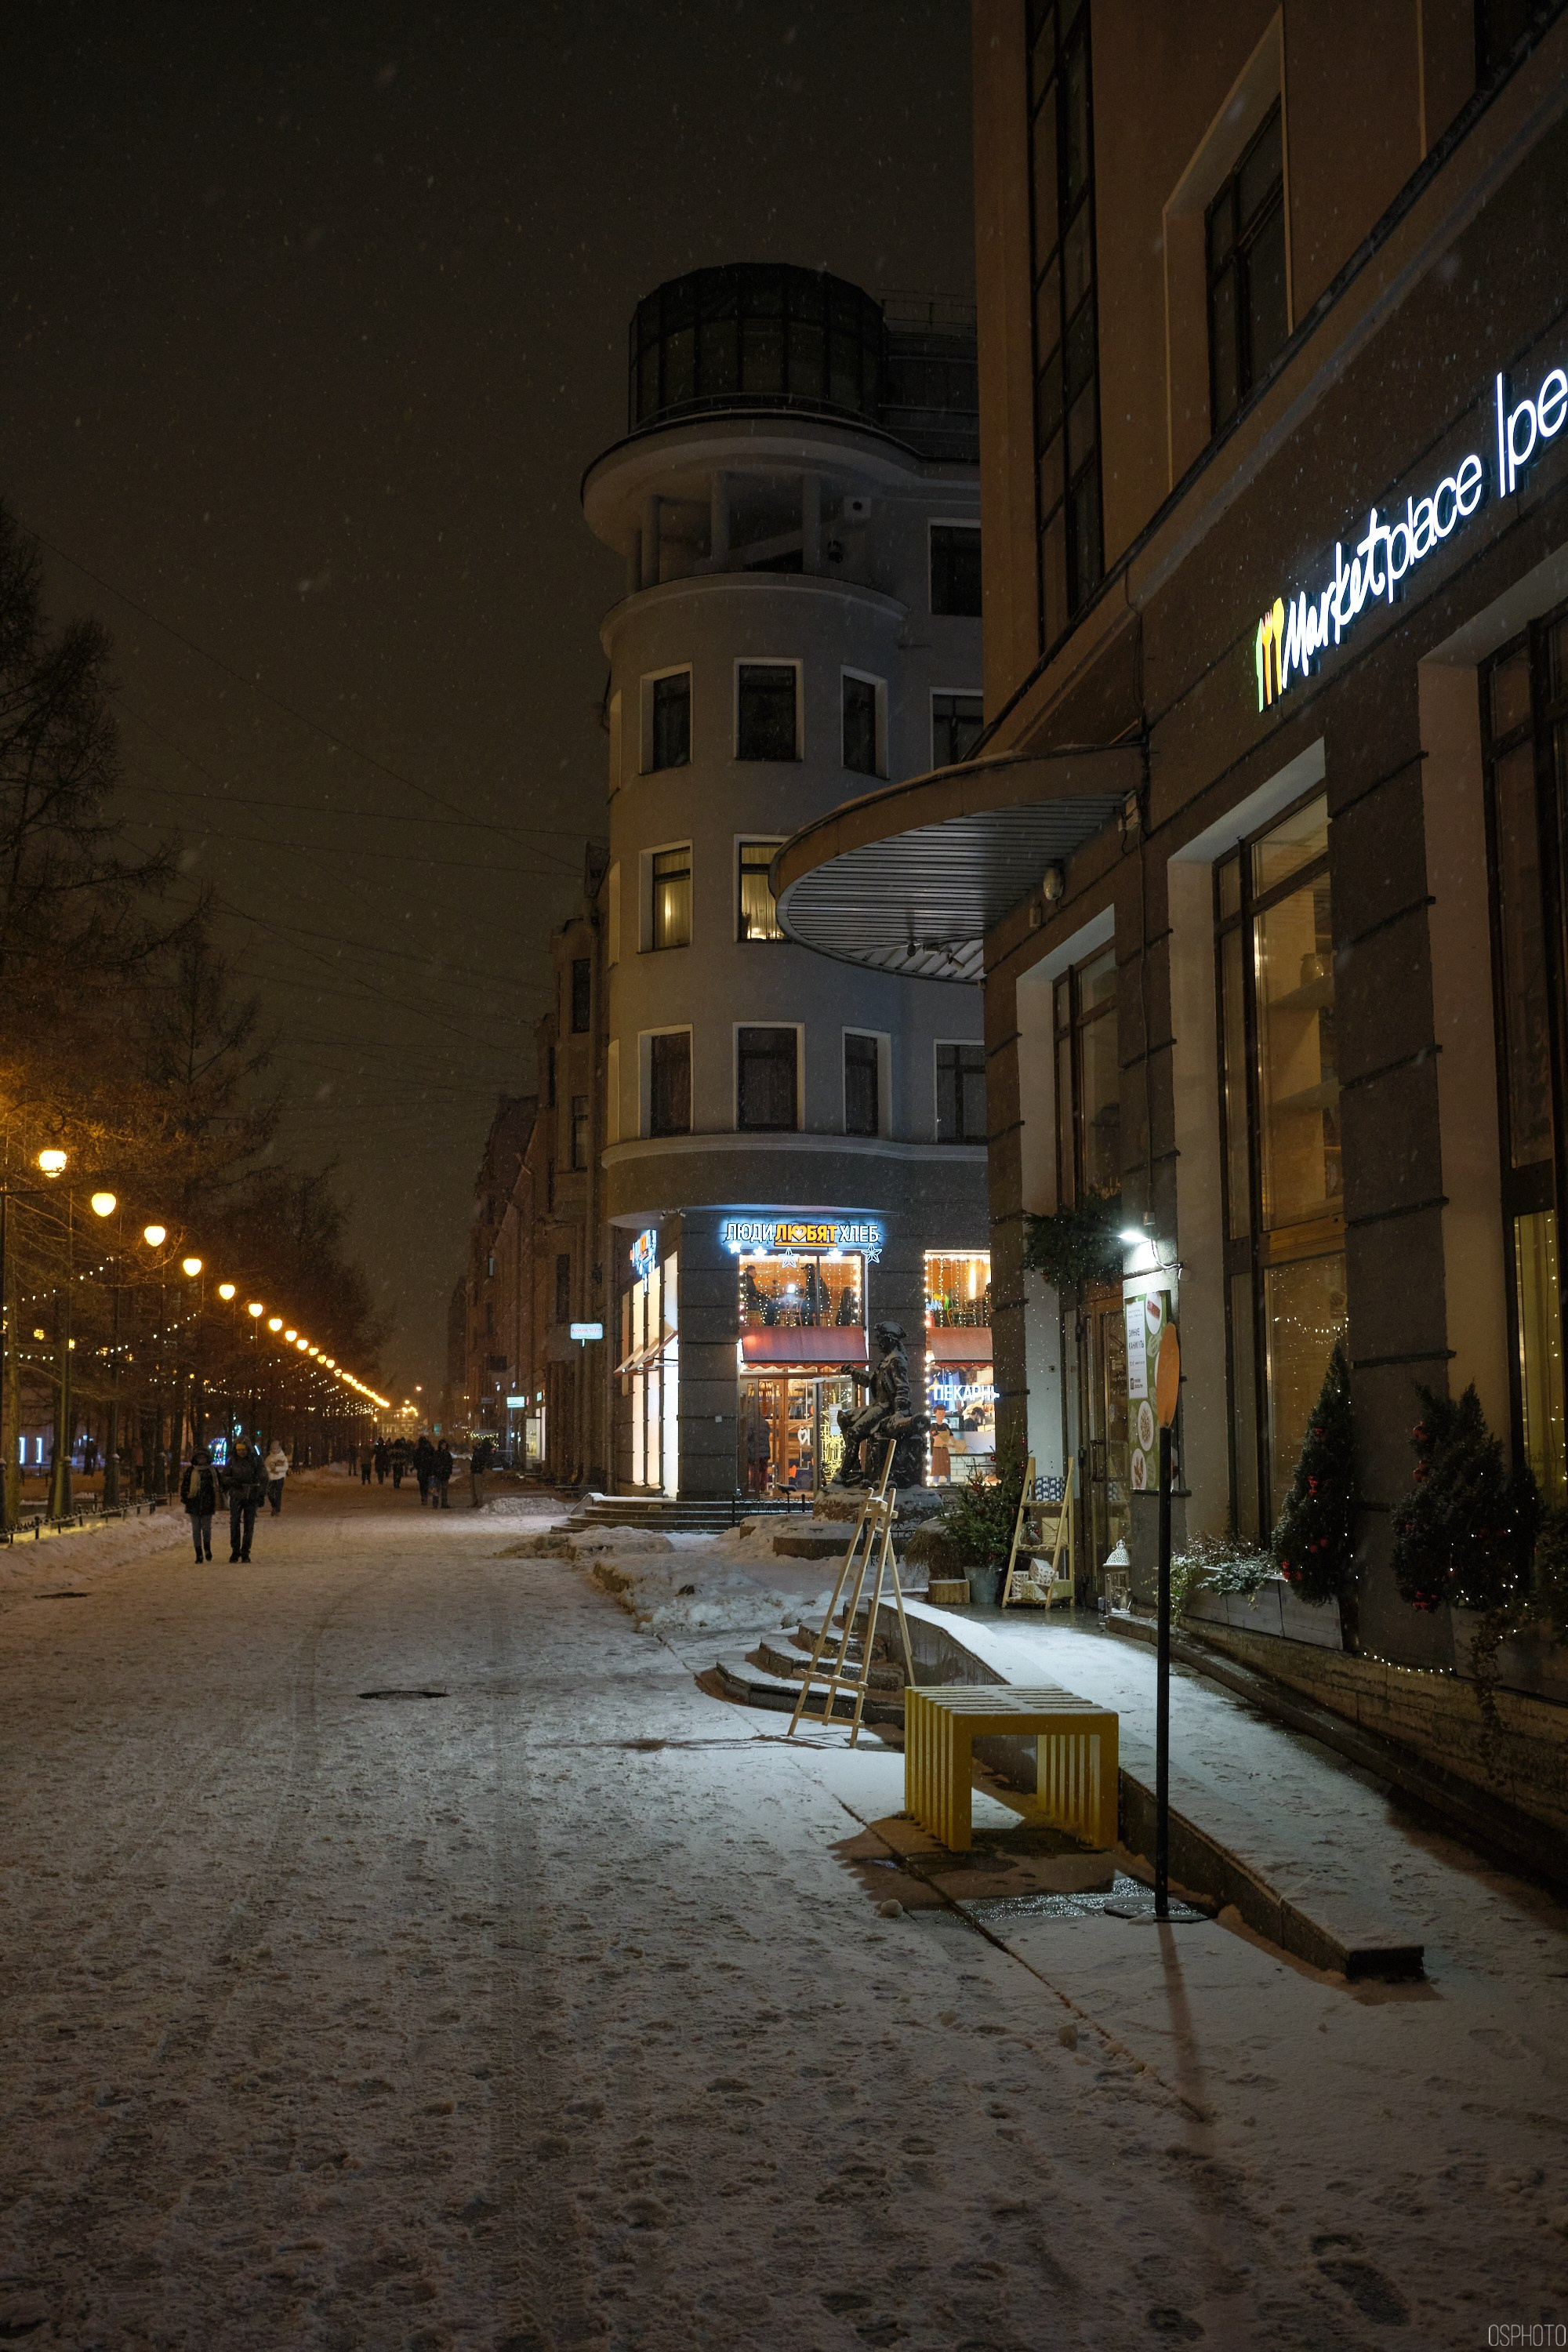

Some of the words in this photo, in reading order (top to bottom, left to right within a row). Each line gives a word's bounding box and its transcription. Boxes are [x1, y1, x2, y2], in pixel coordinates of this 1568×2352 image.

[1283, 454, 1483, 689] Marketplace
[726, 1223, 773, 1243] ЛЮДИ
[774, 1224, 838, 1242] ЛЮБЯТ
[839, 1225, 879, 1243] ХЛЕБ
